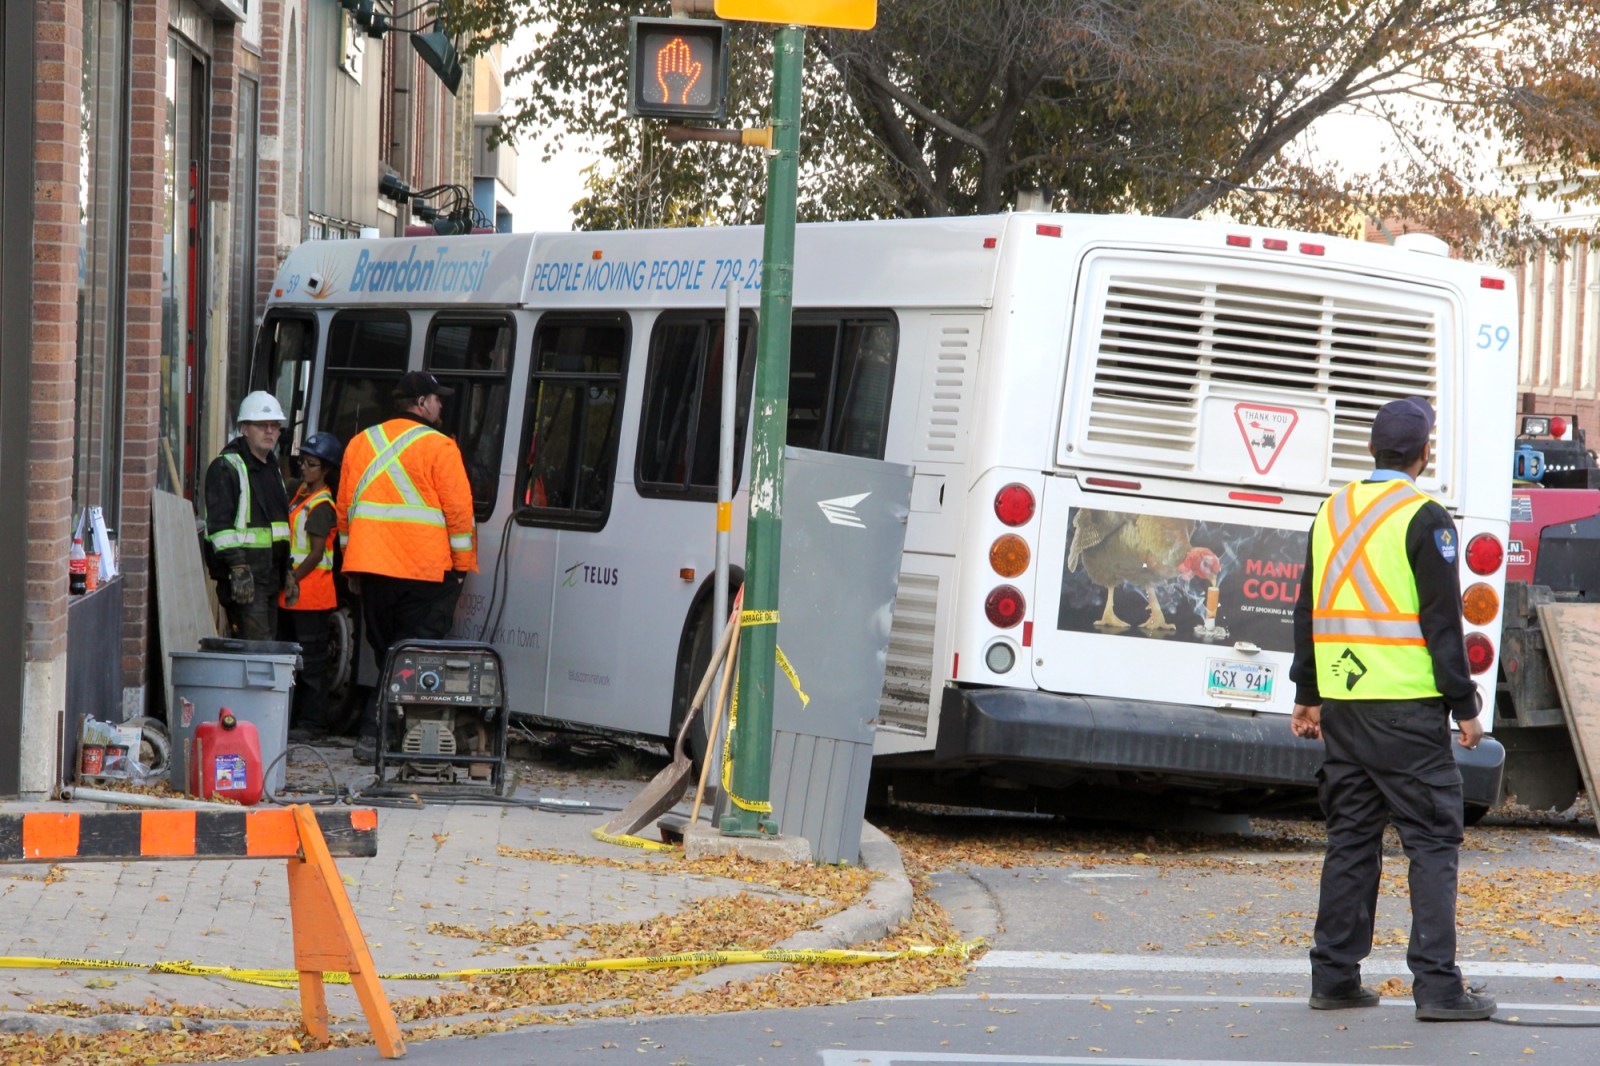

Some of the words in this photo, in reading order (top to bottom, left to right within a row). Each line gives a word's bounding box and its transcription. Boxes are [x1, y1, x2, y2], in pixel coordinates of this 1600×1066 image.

[286, 274, 300, 294] 59
[530, 261, 583, 292] PEOPLE
[582, 260, 647, 292] MOVING
[648, 259, 706, 290] PEOPLE
[1476, 323, 1510, 352] 59
[1245, 411, 1269, 422] THANK
[1272, 414, 1288, 424] YOU
[584, 565, 618, 586] TELUS
[1255, 607, 1281, 615] SMOKING
[1213, 669, 1237, 688] GSX
[1245, 673, 1268, 692] 941
